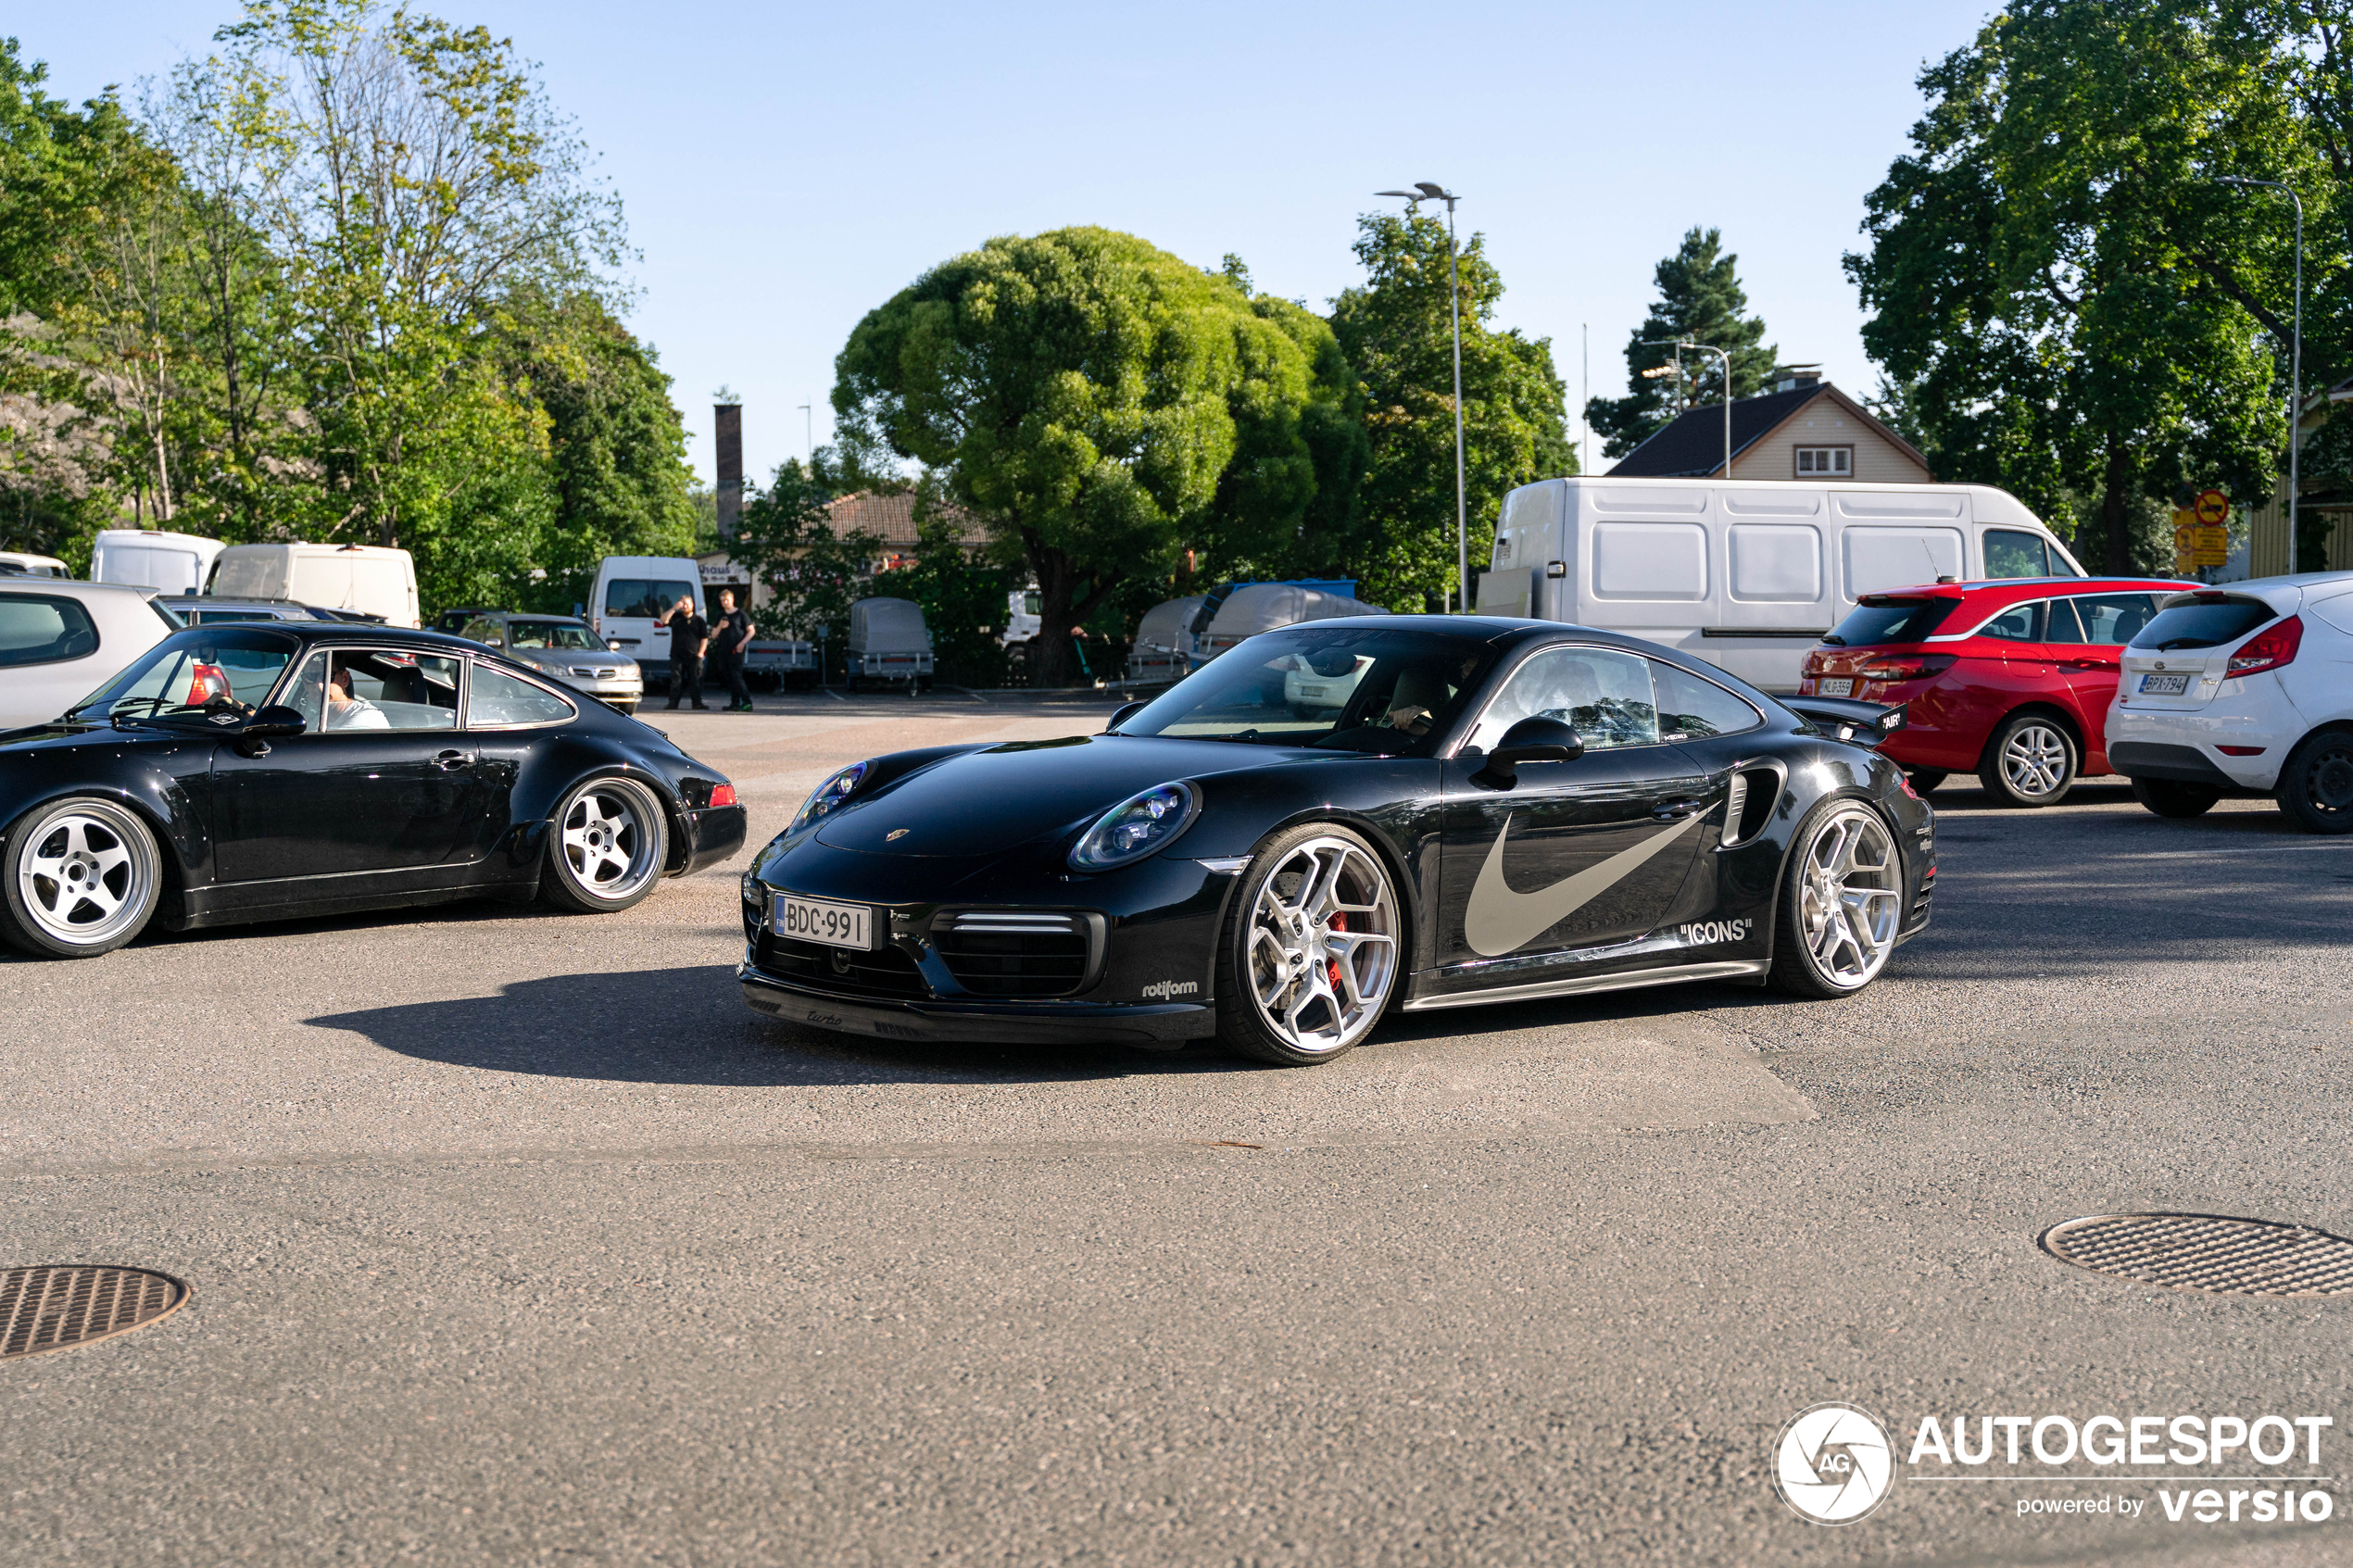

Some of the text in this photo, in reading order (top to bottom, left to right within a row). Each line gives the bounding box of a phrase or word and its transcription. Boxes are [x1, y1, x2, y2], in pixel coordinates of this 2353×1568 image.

[2145, 677, 2183, 691] BPX-794
[1882, 712, 1901, 730] "AIR"
[787, 903, 861, 942] BDC-991
[1680, 918, 1753, 945] "ICONS"
[1142, 980, 1198, 1000] rotiform
